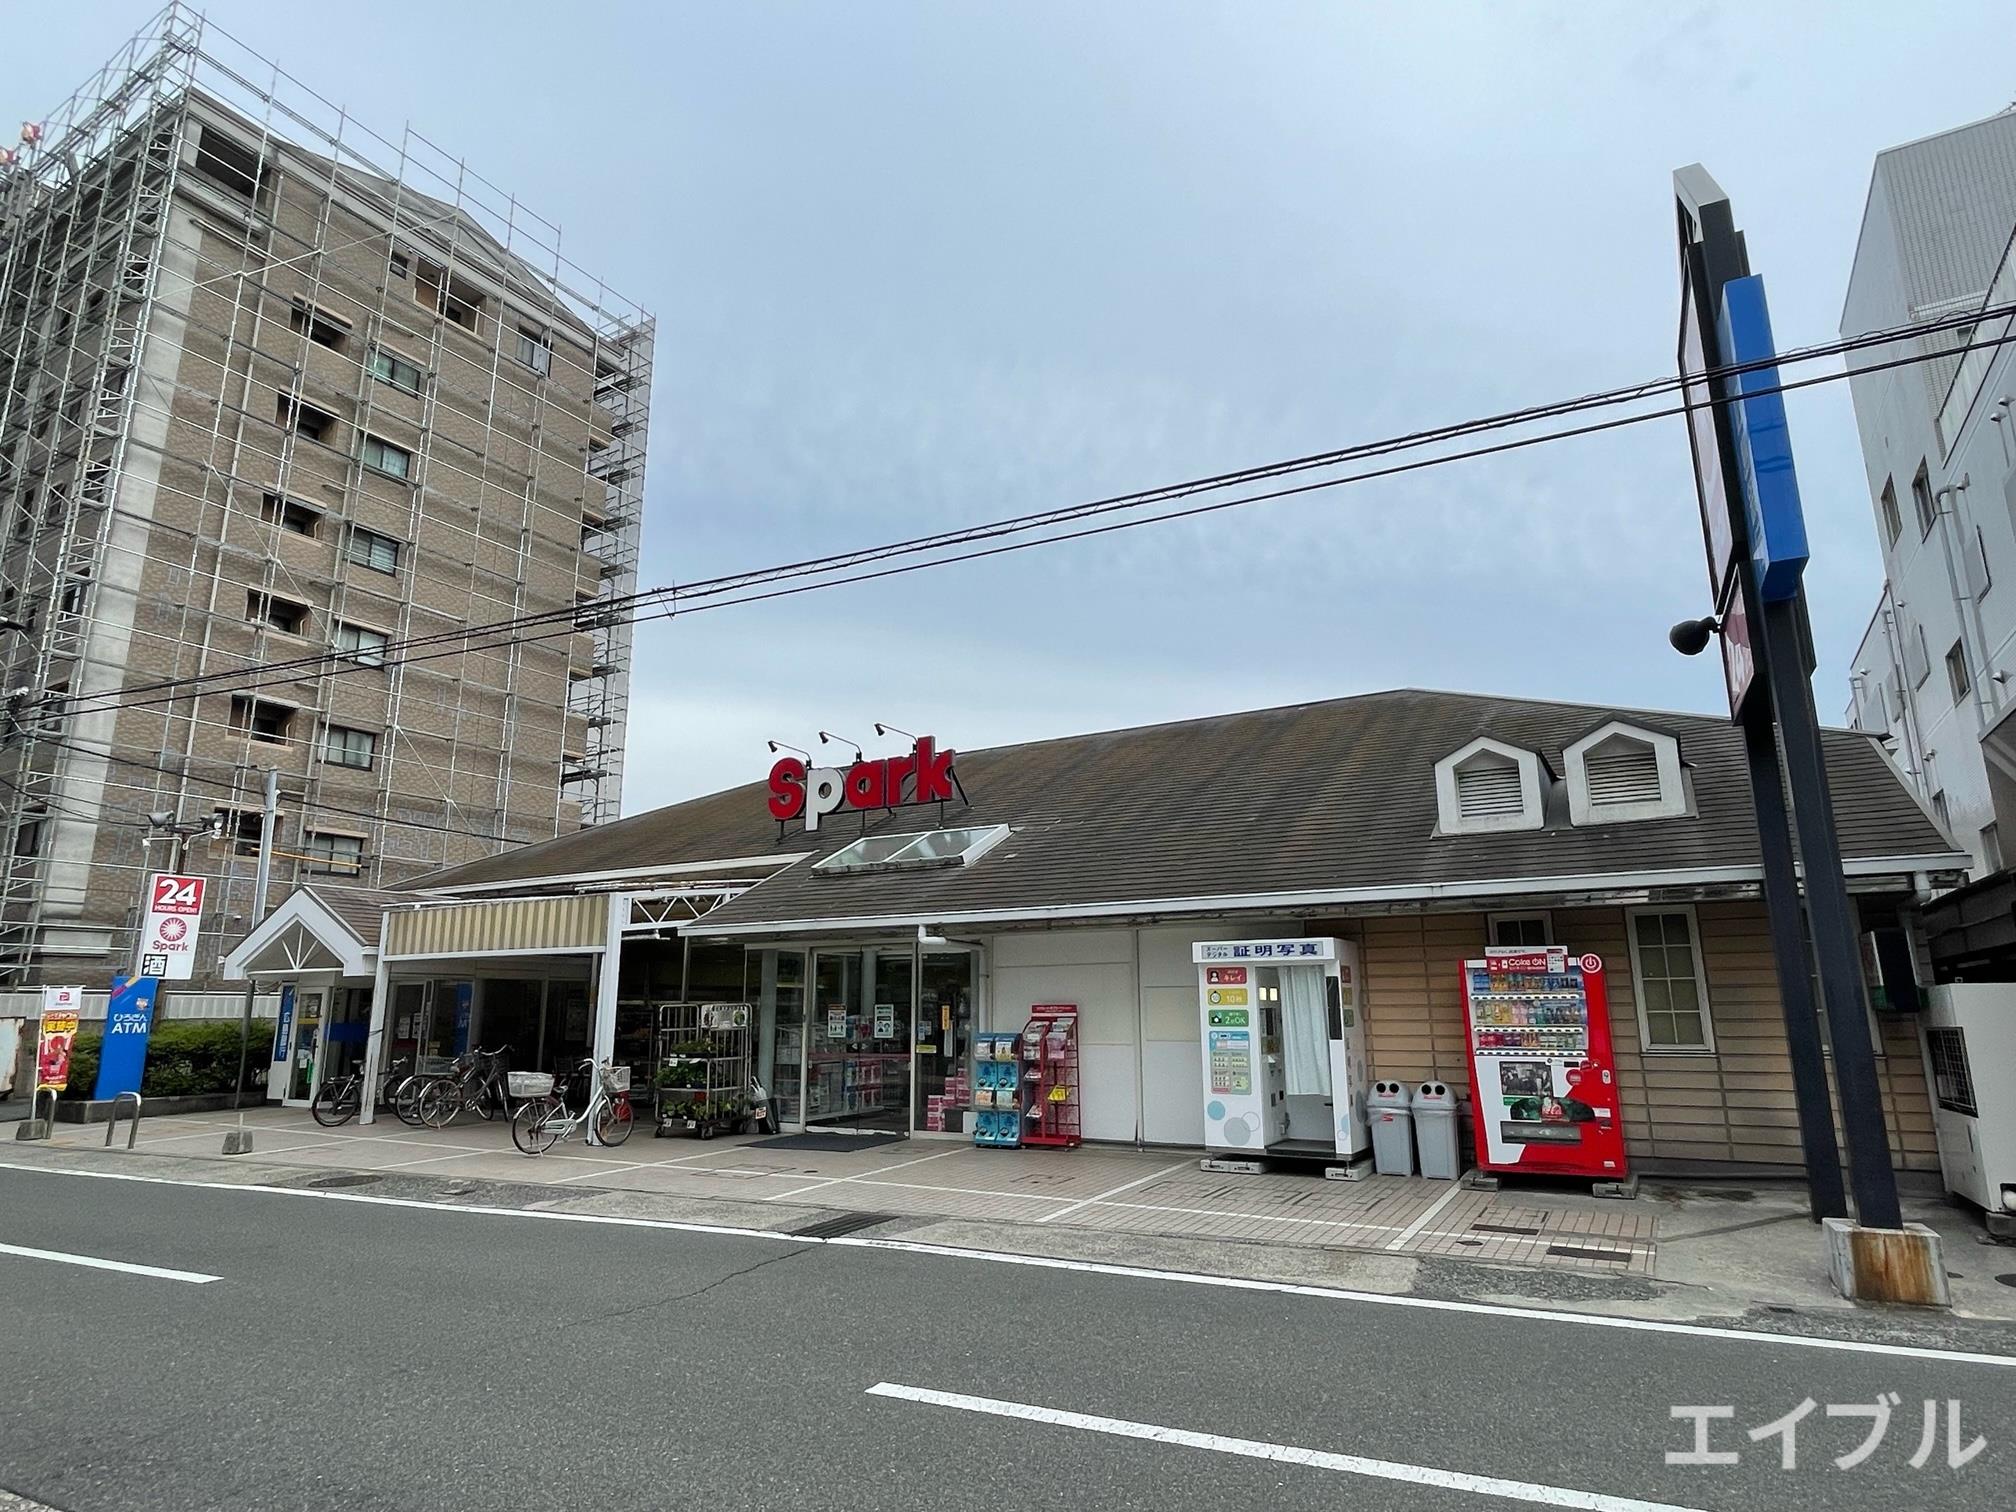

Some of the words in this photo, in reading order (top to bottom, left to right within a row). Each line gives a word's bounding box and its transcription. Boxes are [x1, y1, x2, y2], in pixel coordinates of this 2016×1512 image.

[157, 878, 197, 906] 24
[152, 940, 189, 953] Spark
[1233, 943, 1318, 958] 証明写真
[143, 955, 166, 976] 酒
[1508, 958, 1531, 966] Coke
[113, 1013, 148, 1022] ひろぎん
[111, 1022, 147, 1034] ATM
